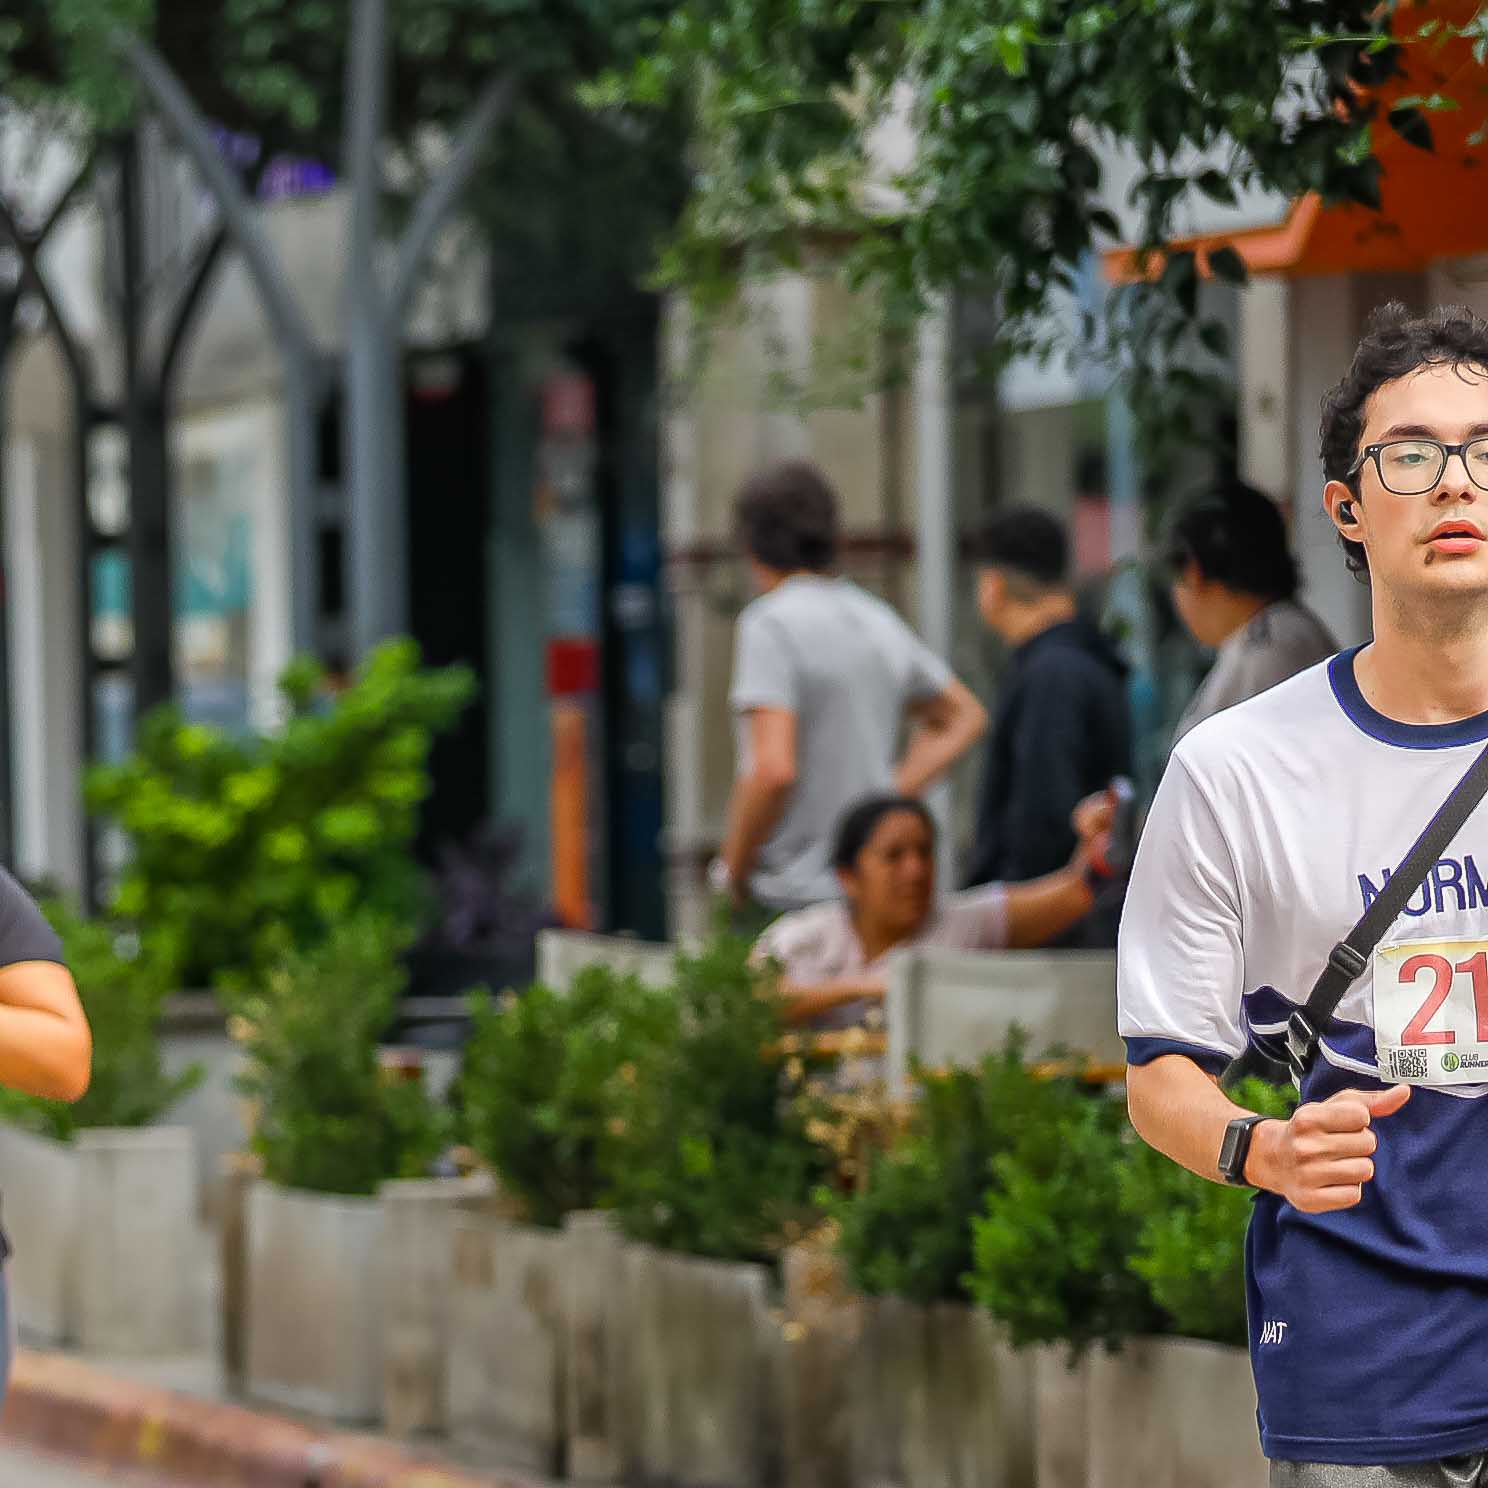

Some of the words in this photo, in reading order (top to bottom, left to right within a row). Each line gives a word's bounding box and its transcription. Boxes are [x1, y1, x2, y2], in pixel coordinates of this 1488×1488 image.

[1398, 951, 1488, 1046] 21
[1460, 1053, 1478, 1062] CLUB
[1259, 1320, 1288, 1345] NAT
